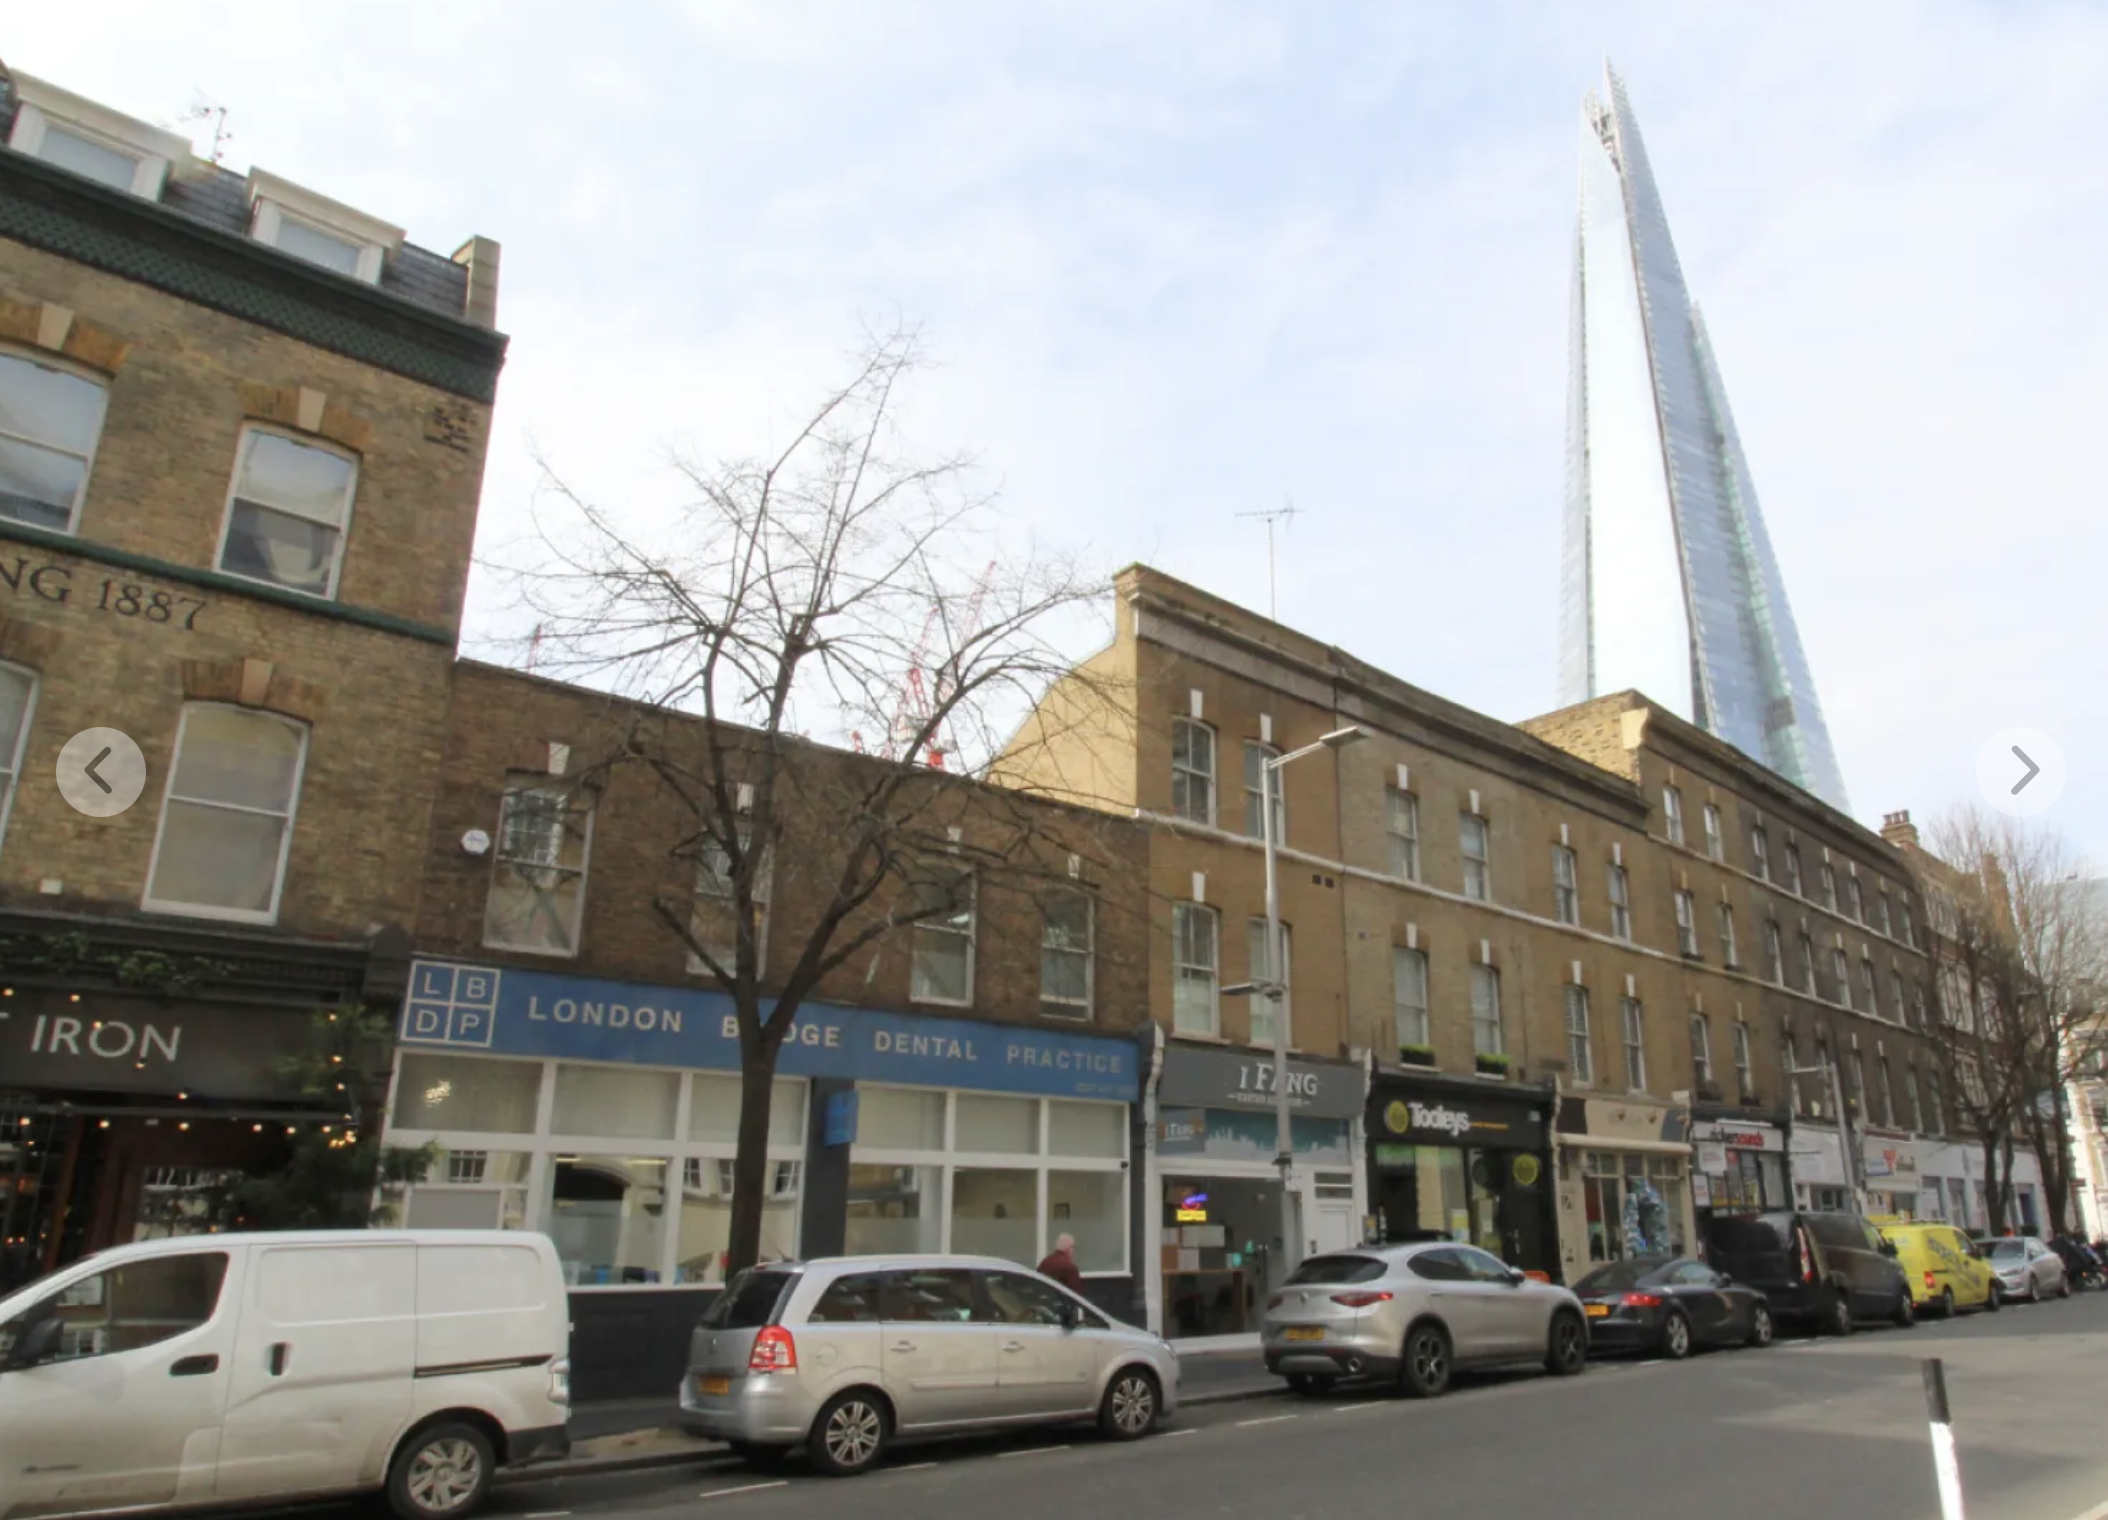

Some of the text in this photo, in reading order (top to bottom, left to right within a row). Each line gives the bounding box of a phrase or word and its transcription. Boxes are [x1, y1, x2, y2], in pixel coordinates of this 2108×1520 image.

[97, 578, 206, 630] 1887
[31, 1014, 181, 1062] IRON
[528, 996, 1122, 1074] LONDON BDGE DENTAL PRACTICE
